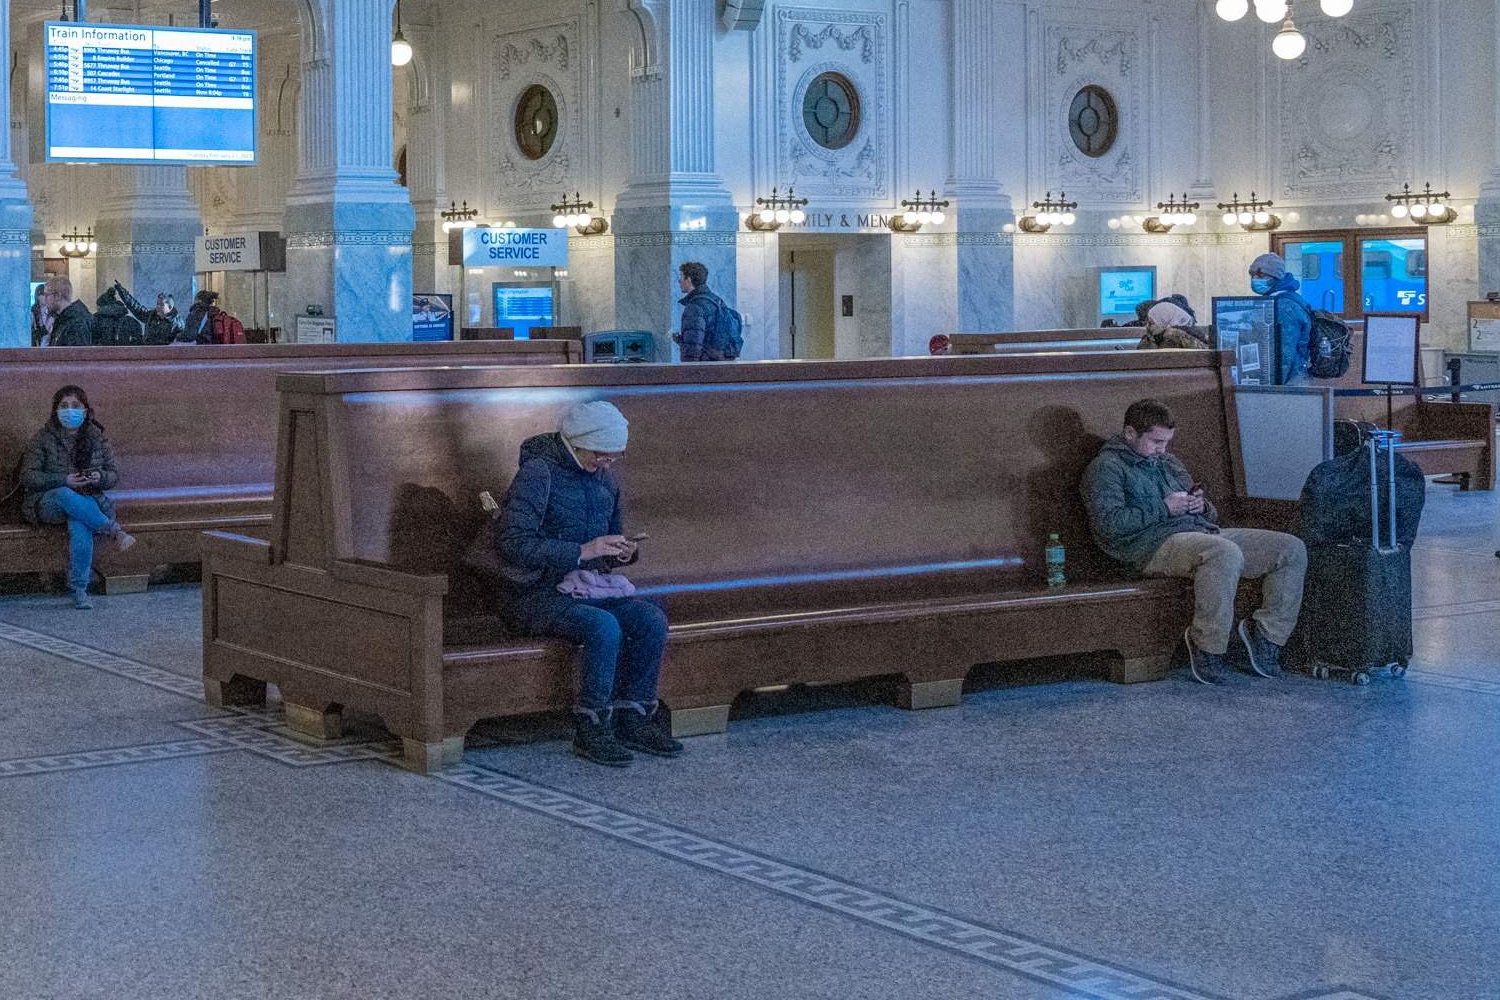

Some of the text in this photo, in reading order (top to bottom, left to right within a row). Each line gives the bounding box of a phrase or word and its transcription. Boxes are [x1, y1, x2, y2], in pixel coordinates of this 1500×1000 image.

[50, 27, 146, 41] Train Information
[51, 94, 87, 102] Messaging
[840, 215, 853, 228] &
[857, 215, 888, 228] MEN
[204, 237, 246, 250] CUSTOMER
[481, 232, 547, 245] CUSTOMER
[209, 251, 242, 264] SERVICE
[489, 247, 540, 259] SERVICE
